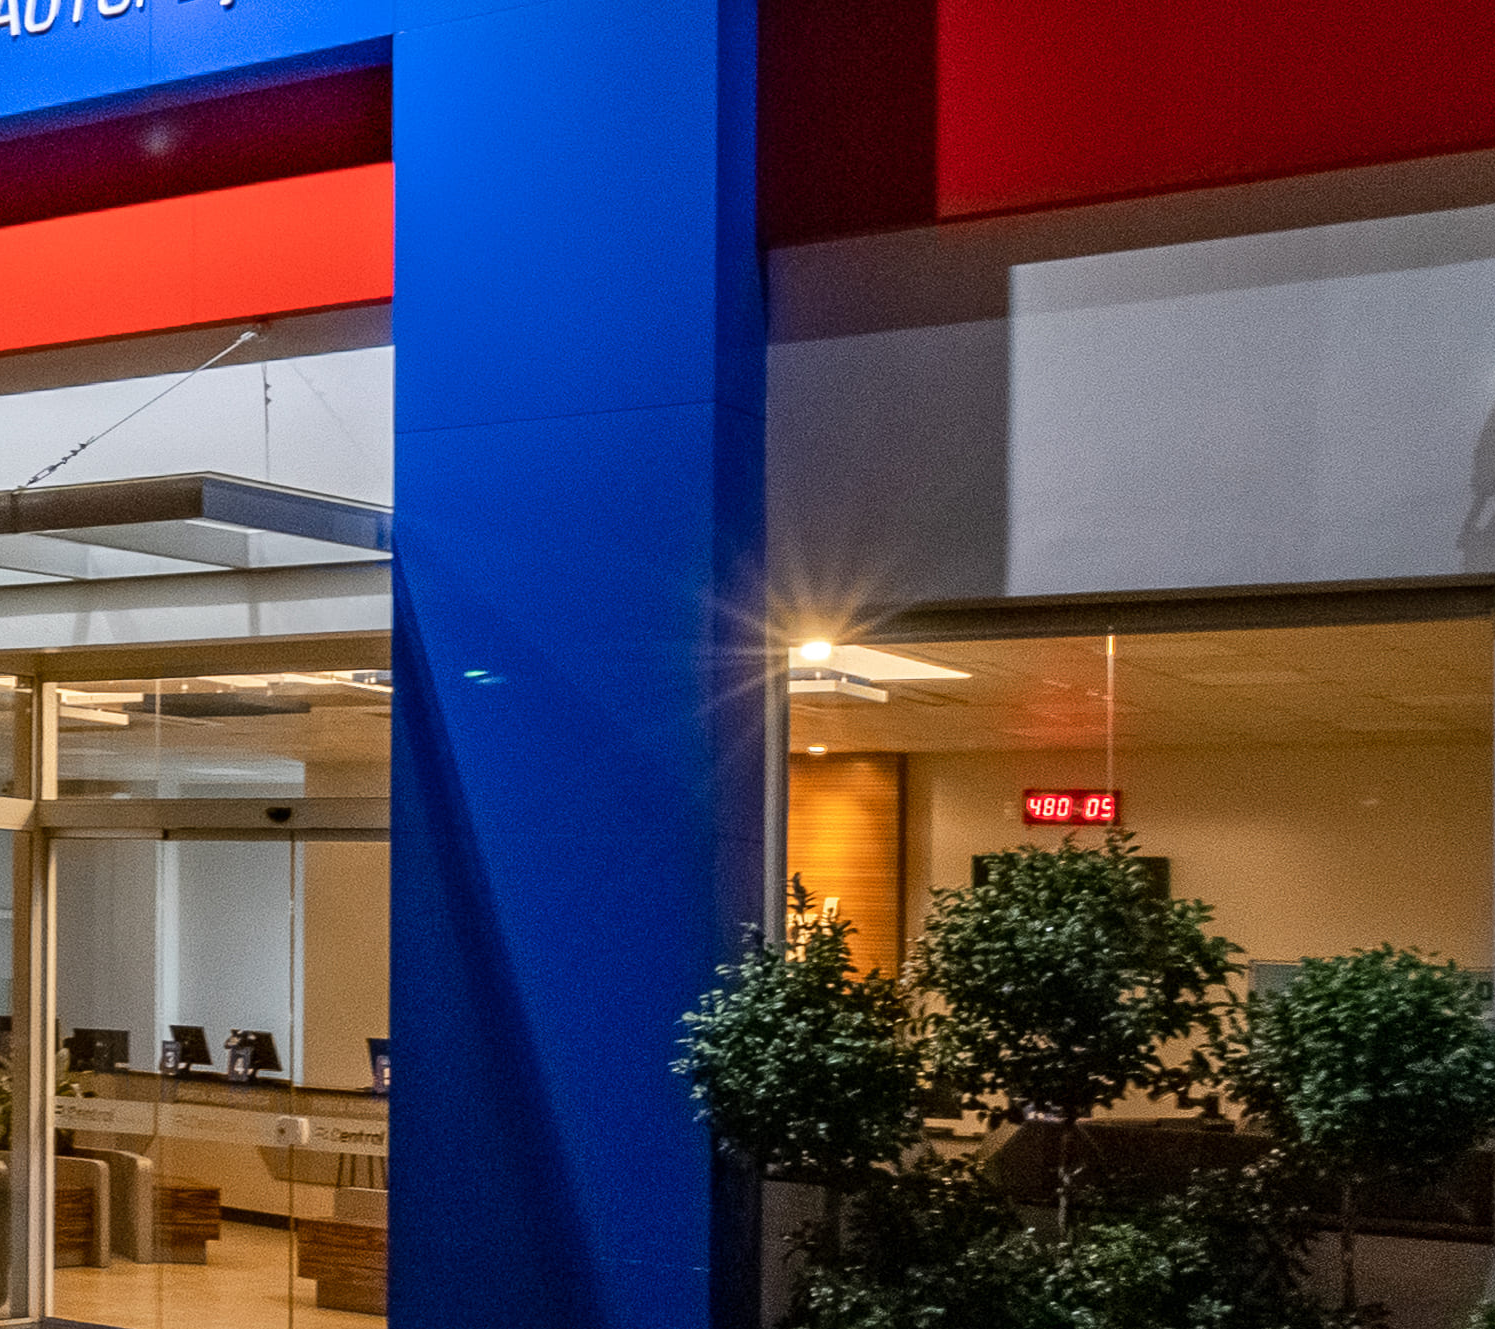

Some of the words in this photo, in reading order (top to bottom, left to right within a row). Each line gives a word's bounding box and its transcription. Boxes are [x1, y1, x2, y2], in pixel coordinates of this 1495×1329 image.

[1027, 797, 1070, 818] 480
[1085, 797, 1113, 819] 05
[233, 1057, 246, 1075] 4
[330, 1127, 386, 1146] Central
